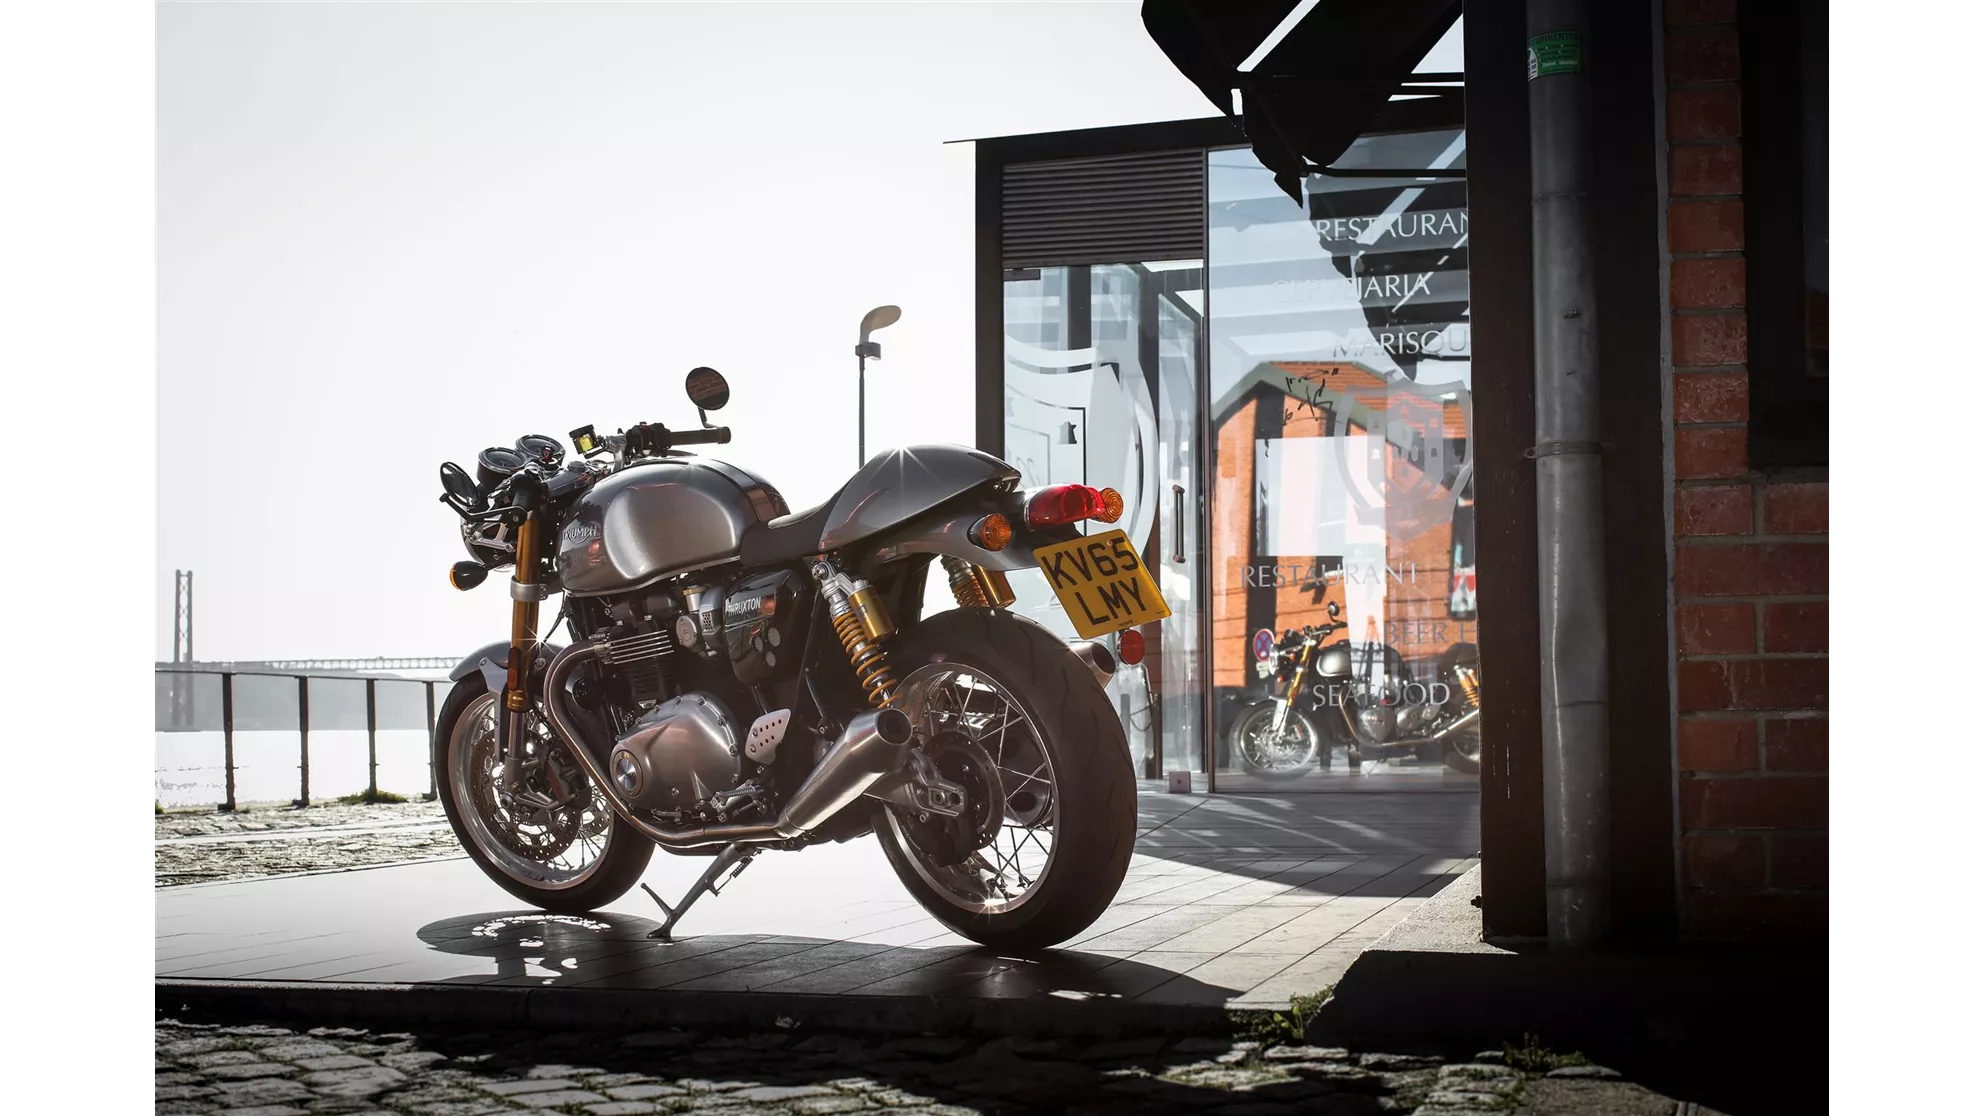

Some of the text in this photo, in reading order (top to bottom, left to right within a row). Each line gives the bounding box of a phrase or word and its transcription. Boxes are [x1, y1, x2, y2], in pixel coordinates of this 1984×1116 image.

[562, 525, 597, 540] TRIUMPH
[1041, 537, 1139, 589] KV65
[1241, 562, 1417, 588] RESTAURANT
[728, 597, 761, 617] THRUXTON
[1074, 576, 1147, 626] LMY
[1383, 621, 1448, 646] BEER
[1312, 682, 1450, 708] SEAFOOD
